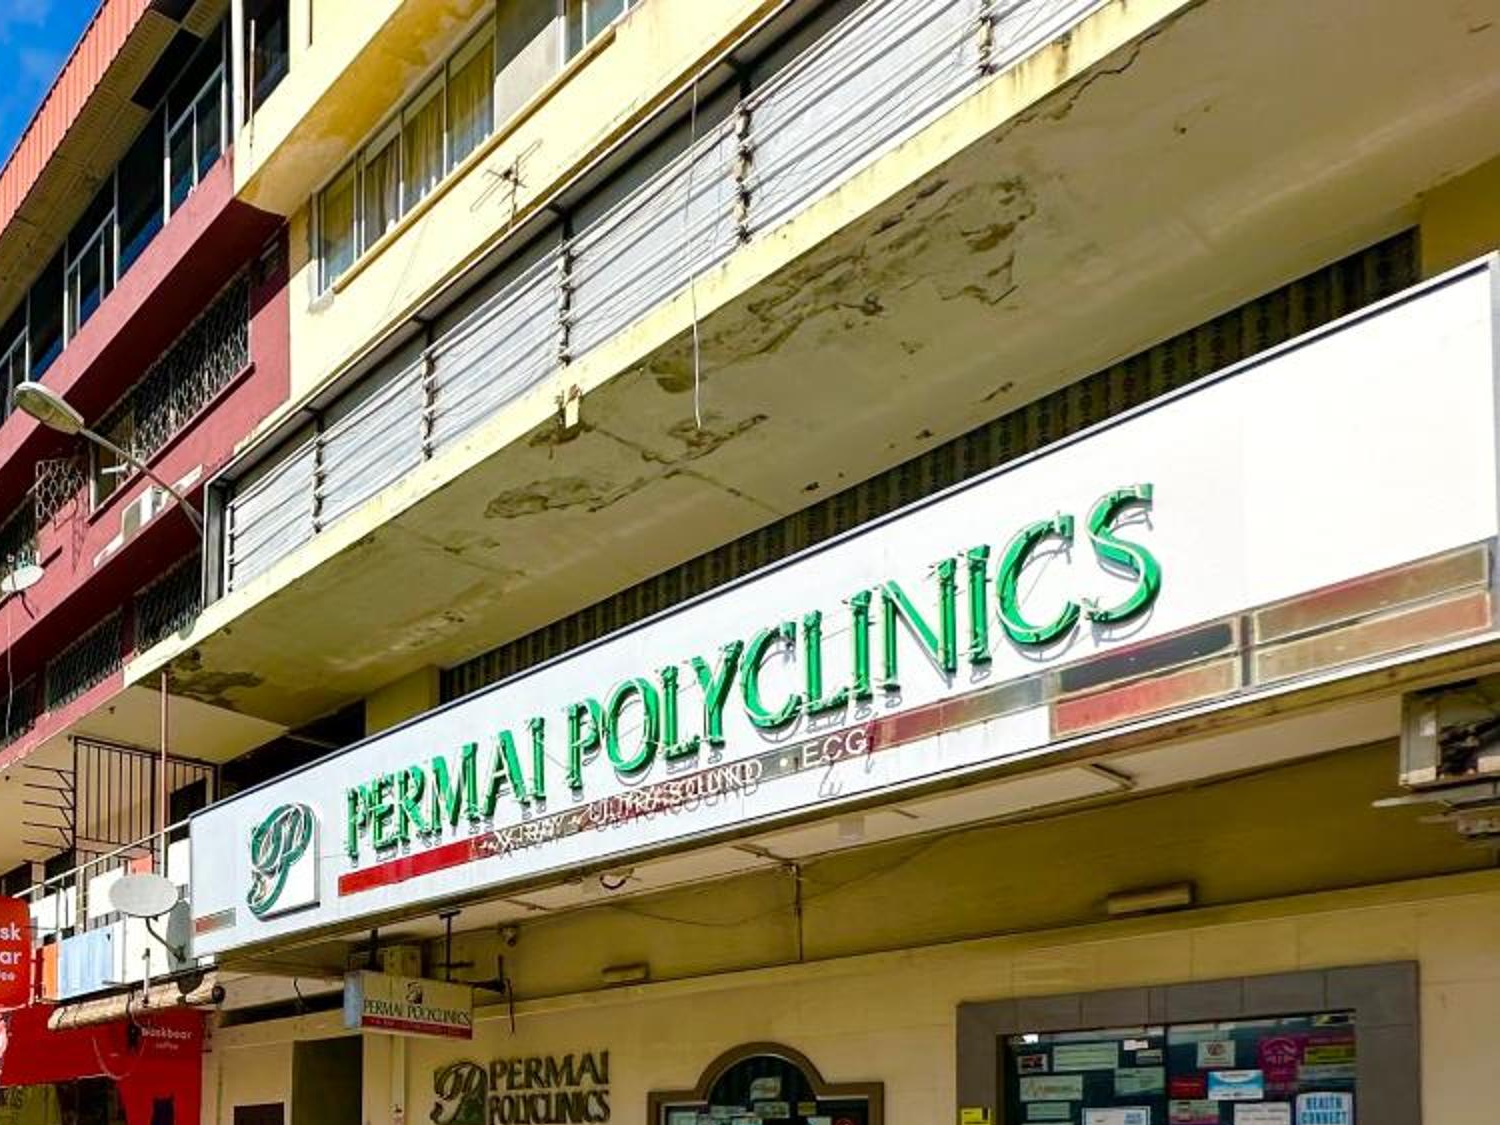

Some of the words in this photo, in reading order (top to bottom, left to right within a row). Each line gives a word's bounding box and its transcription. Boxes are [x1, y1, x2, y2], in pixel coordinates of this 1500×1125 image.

[345, 716, 546, 861] PERMAI
[565, 482, 1162, 790] POLYCLINICS
[803, 729, 867, 767] ECG
[364, 1000, 403, 1016] PERMAI
[407, 1005, 469, 1024] POLYCLINICS
[488, 1050, 610, 1092] PERMAI
[1301, 1111, 1348, 1125] CONNECT
